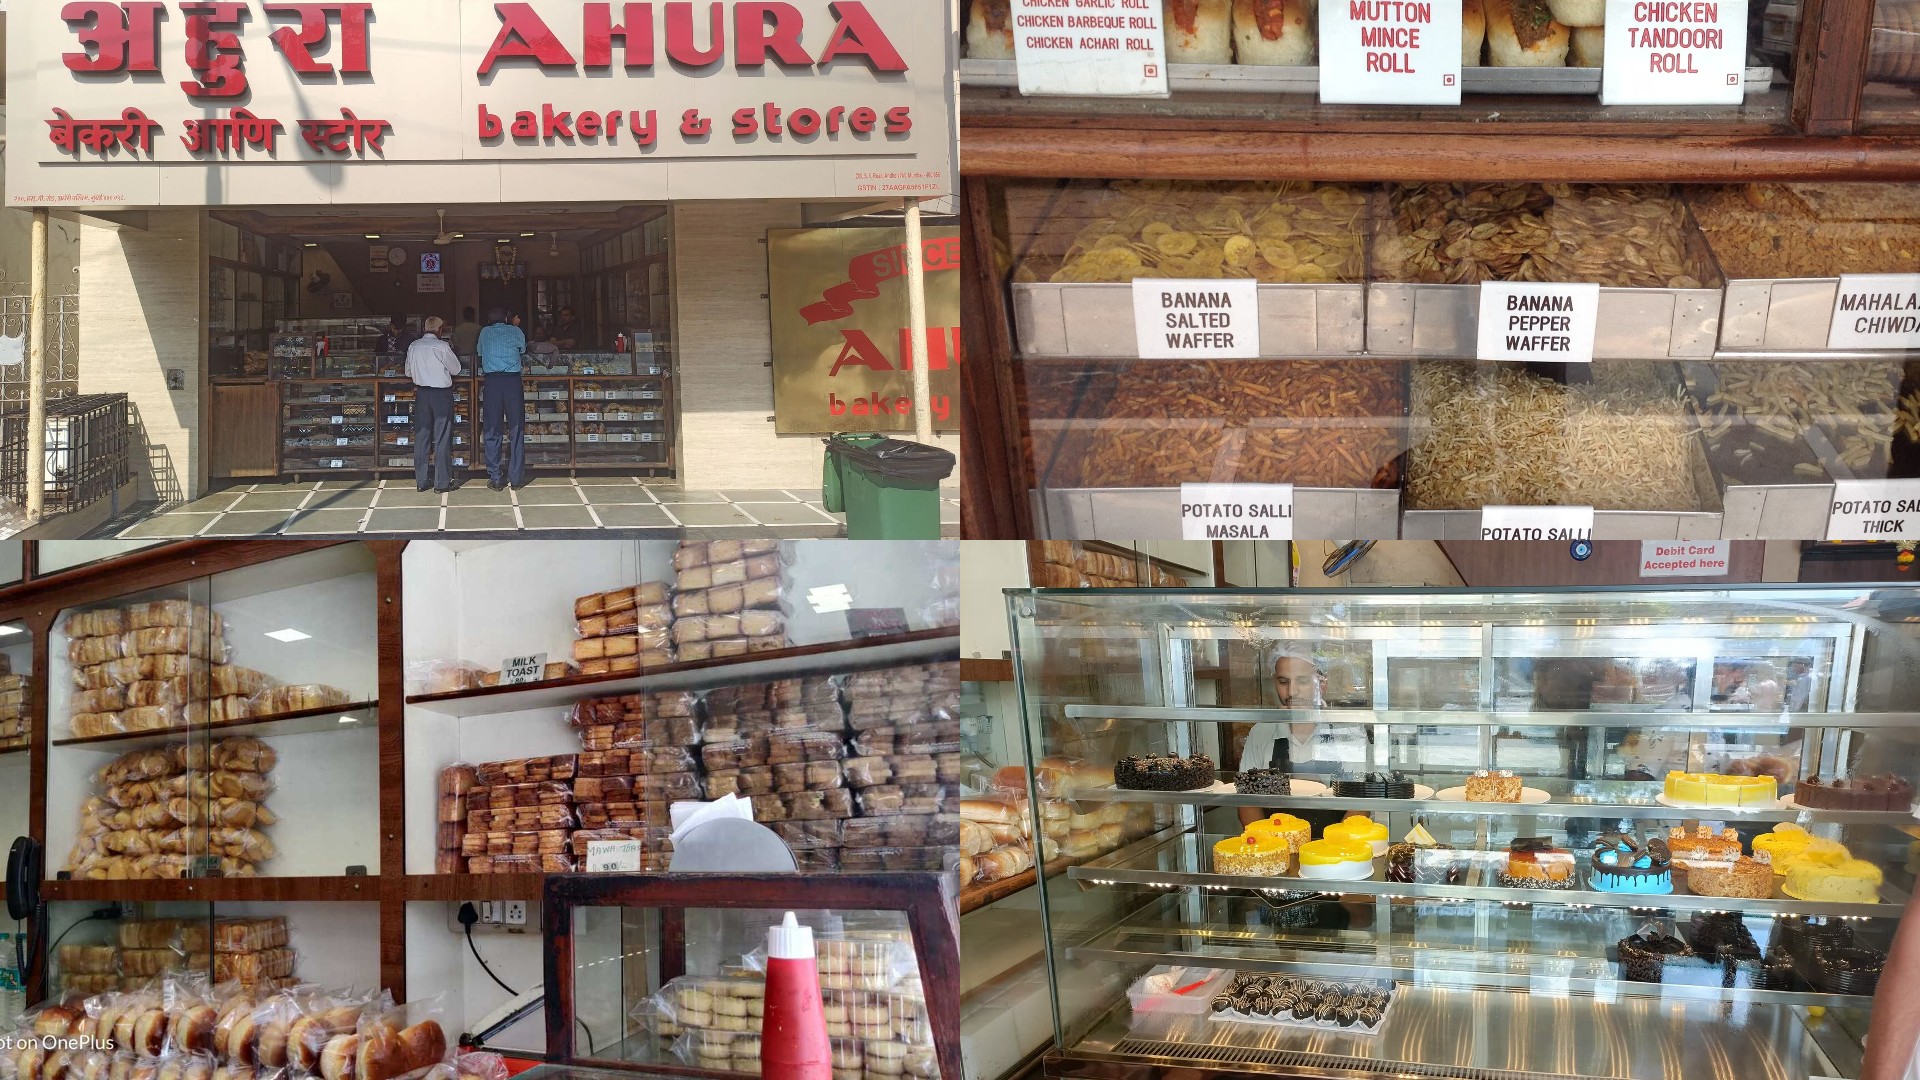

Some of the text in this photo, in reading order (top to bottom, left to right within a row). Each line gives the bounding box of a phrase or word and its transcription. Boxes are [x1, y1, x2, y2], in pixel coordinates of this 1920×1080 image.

[1350, 0, 1431, 23] MUTTON
[1634, 1, 1718, 23] CHICKEN
[1017, 15, 1157, 29] CHICKEN BARBEQUE ROLL
[477, 1, 909, 76] AHURA
[1026, 37, 1153, 50] CHICKEN ACHARI ROLL
[1361, 28, 1420, 49] MINCE
[1627, 28, 1723, 50] TANDOORI
[60, 1, 376, 98] अहुरा
[1366, 53, 1416, 74] ROLL
[1649, 53, 1698, 74] ROLL
[44, 106, 392, 153] बेकरी आणि स्टोर
[478, 102, 913, 145] bakery & stores
[872, 241, 960, 277] SICE
[1161, 292, 1232, 309] BANANA
[1507, 295, 1574, 312] BANANA
[1840, 293, 1920, 311] MAHALA
[1166, 313, 1231, 329] SALTED
[1508, 315, 1571, 332] PEPPER
[1165, 332, 1235, 350] WAFFER
[1505, 334, 1571, 352] WAFFER
[830, 391, 950, 420] bakey
[1181, 503, 1293, 519] POTATO SALLI
[1832, 501, 1892, 514] POTATO
[1206, 524, 1270, 540] MASALA
[1481, 527, 1592, 540] POTATO SALLI
[1863, 520, 1905, 533] THICK
[1656, 545, 1715, 556] Debit Card
[1644, 558, 1725, 571] Accepted here
[512, 656, 536, 667] MILK
[507, 665, 539, 678] TOAST
